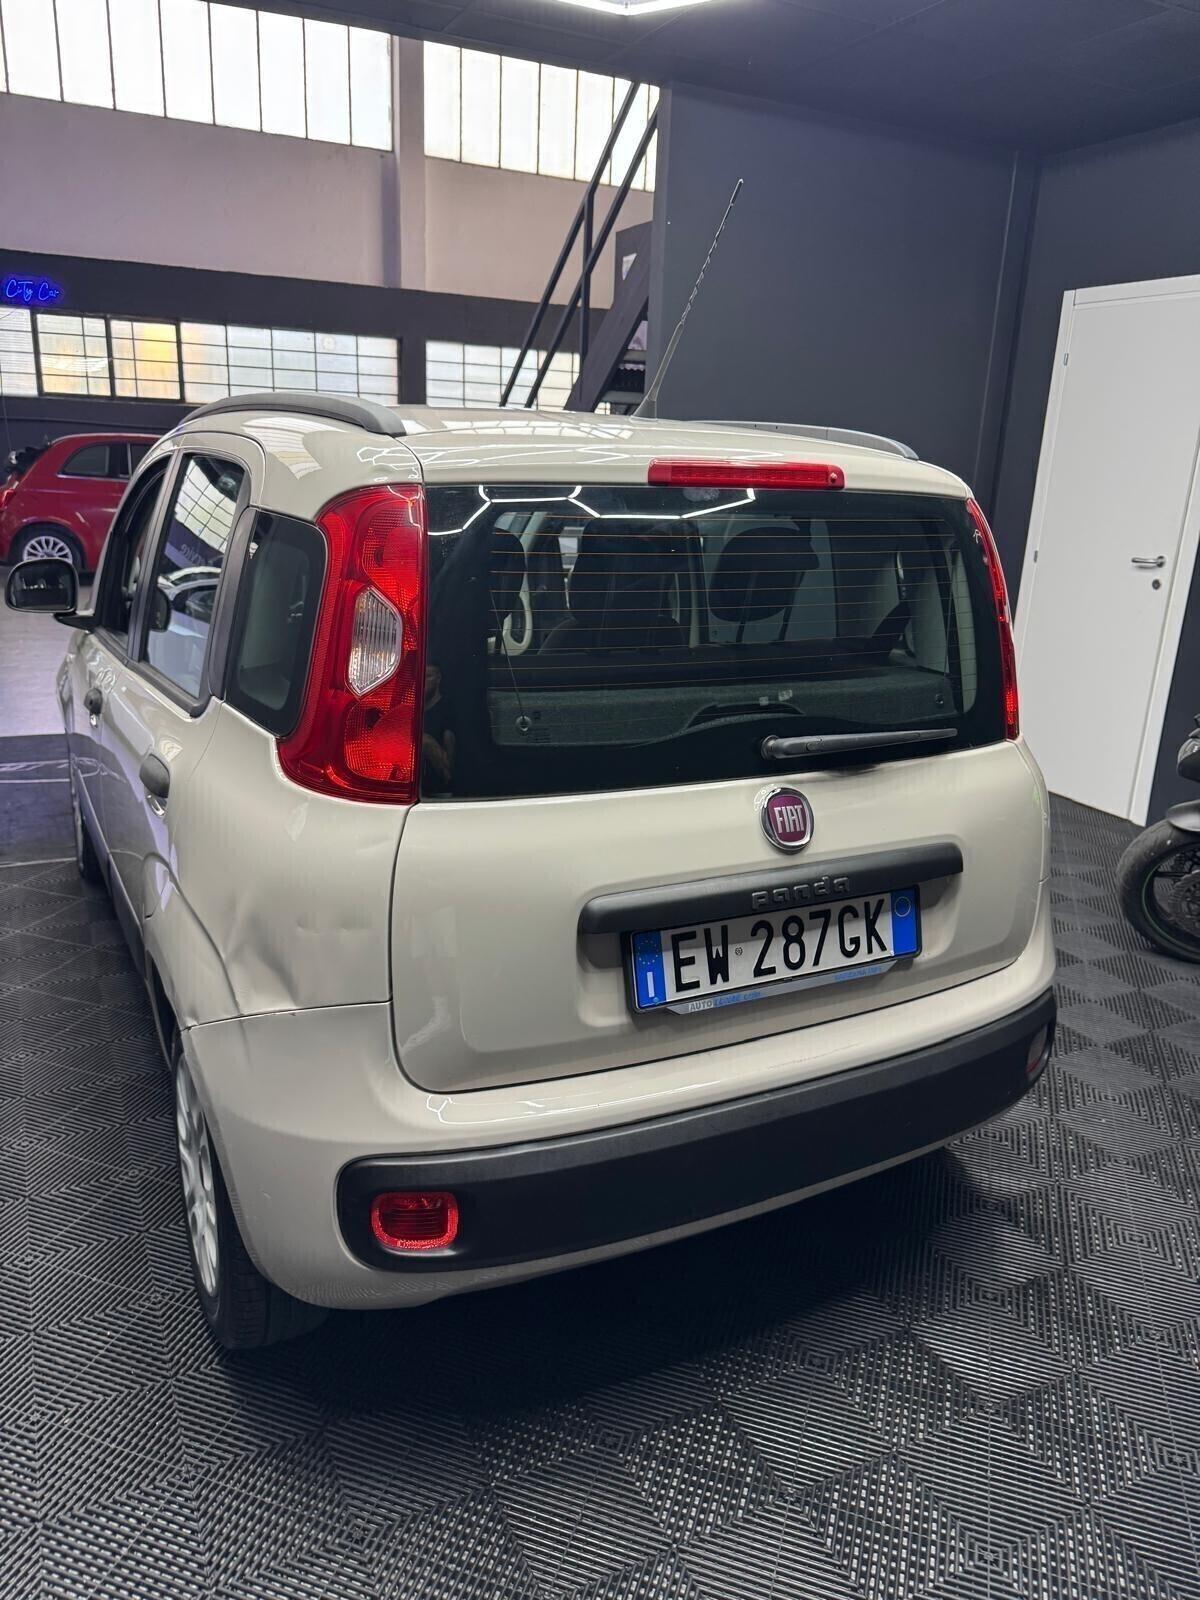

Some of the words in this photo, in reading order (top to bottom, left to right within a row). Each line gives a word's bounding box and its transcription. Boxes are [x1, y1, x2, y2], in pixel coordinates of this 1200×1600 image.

[38, 282, 60, 301] Car
[773, 804, 805, 834] FIAT
[751, 876, 850, 911] panda
[671, 925, 730, 993] EW
[750, 898, 888, 979] 287GK
[646, 971, 655, 998] I
